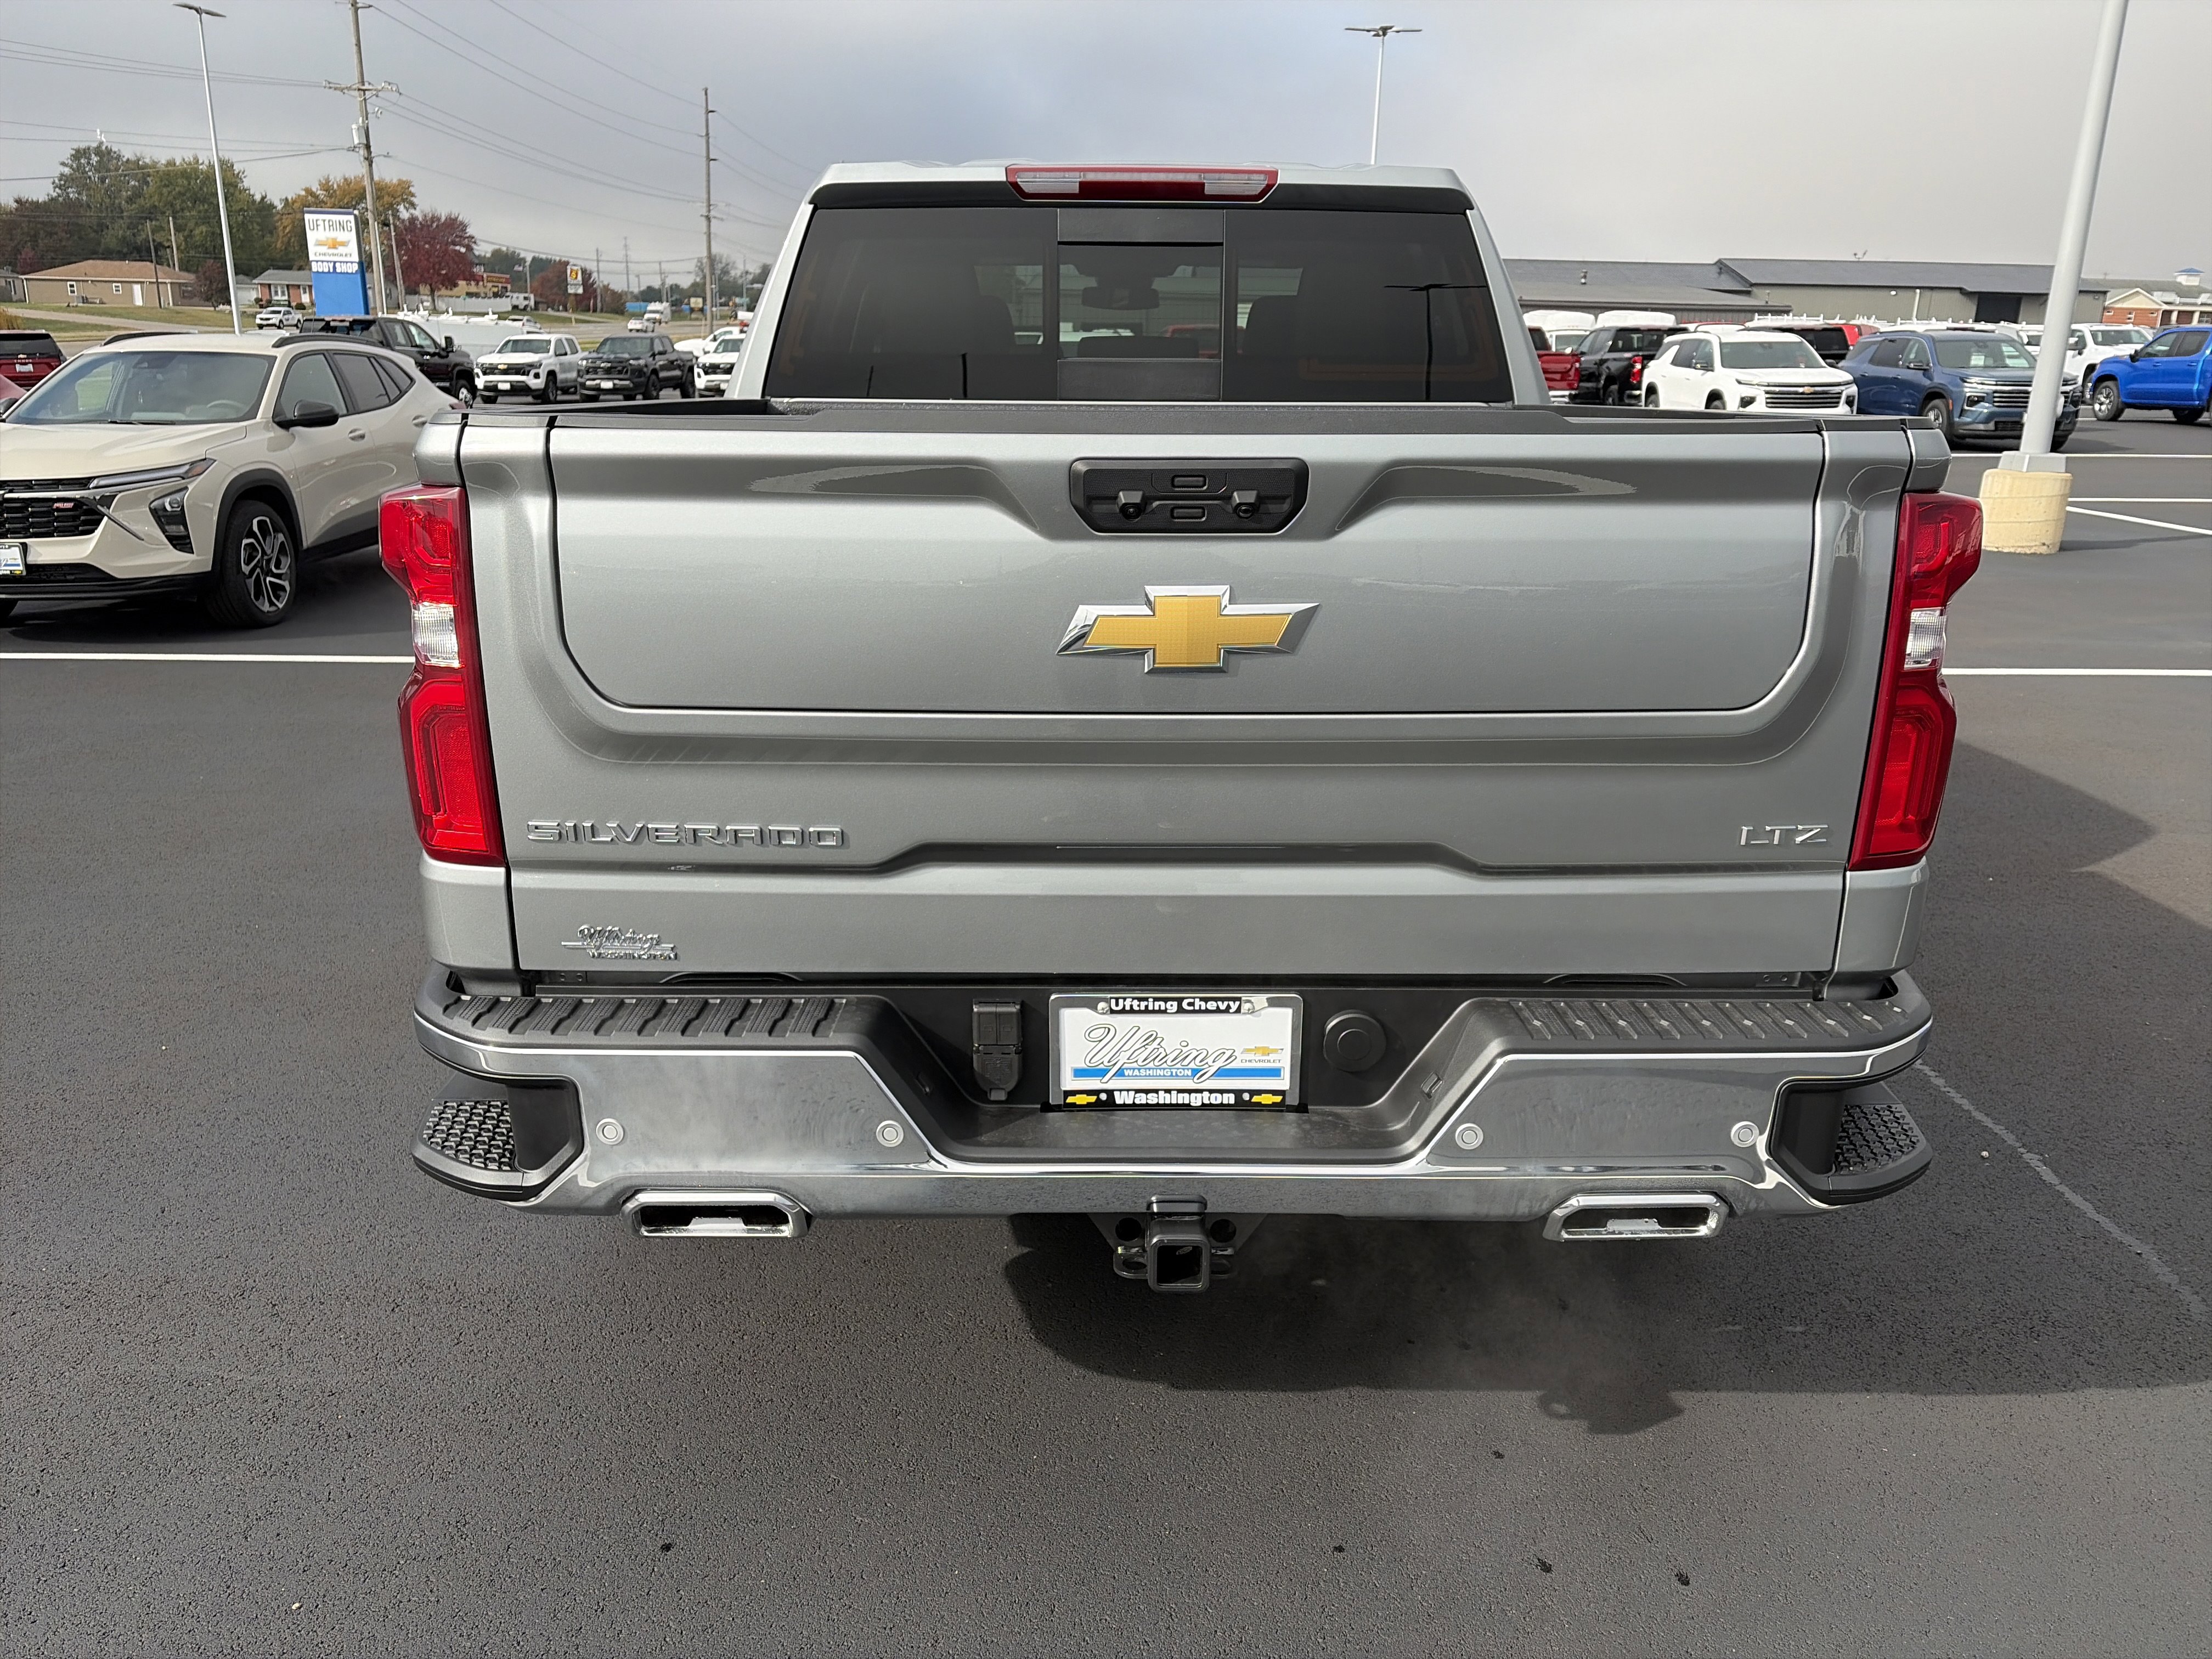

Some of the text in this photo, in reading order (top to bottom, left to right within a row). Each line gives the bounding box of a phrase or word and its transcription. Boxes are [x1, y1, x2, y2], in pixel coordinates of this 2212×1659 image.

[308, 218, 352, 232] UFTRING
[312, 261, 358, 273] BODY SHOP
[527, 820, 844, 846] SILVERADO
[1740, 824, 1829, 845] LTZ
[1110, 998, 1240, 1013] Uftring Chevy
[1084, 1023, 1237, 1084] Uftring
[1113, 1091, 1235, 1107] Washington
